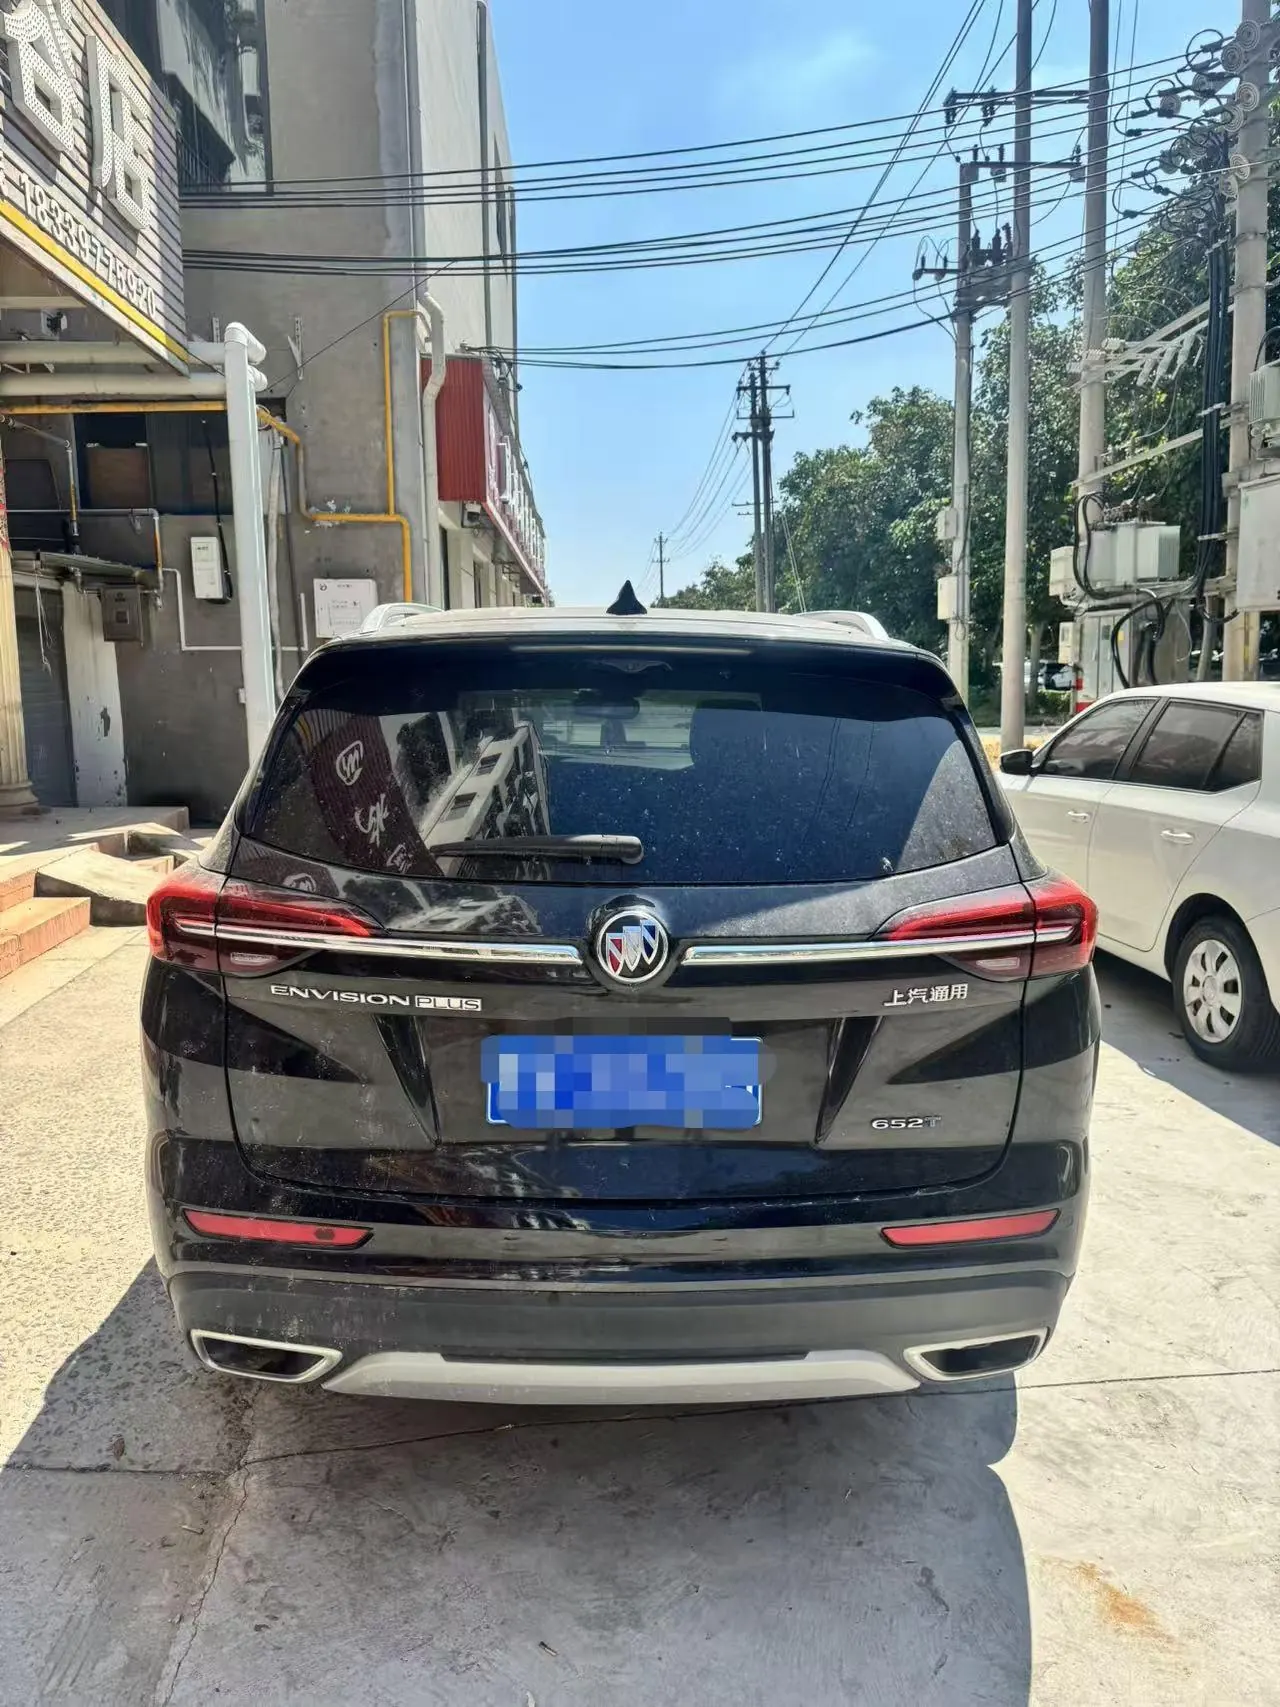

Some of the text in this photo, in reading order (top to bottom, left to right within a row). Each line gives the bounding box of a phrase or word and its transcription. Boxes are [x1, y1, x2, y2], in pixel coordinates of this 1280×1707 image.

[270, 984, 482, 1011] ENVISION PLUS
[883, 983, 969, 1007] 上汽通用
[871, 1116, 942, 1130] 652T
